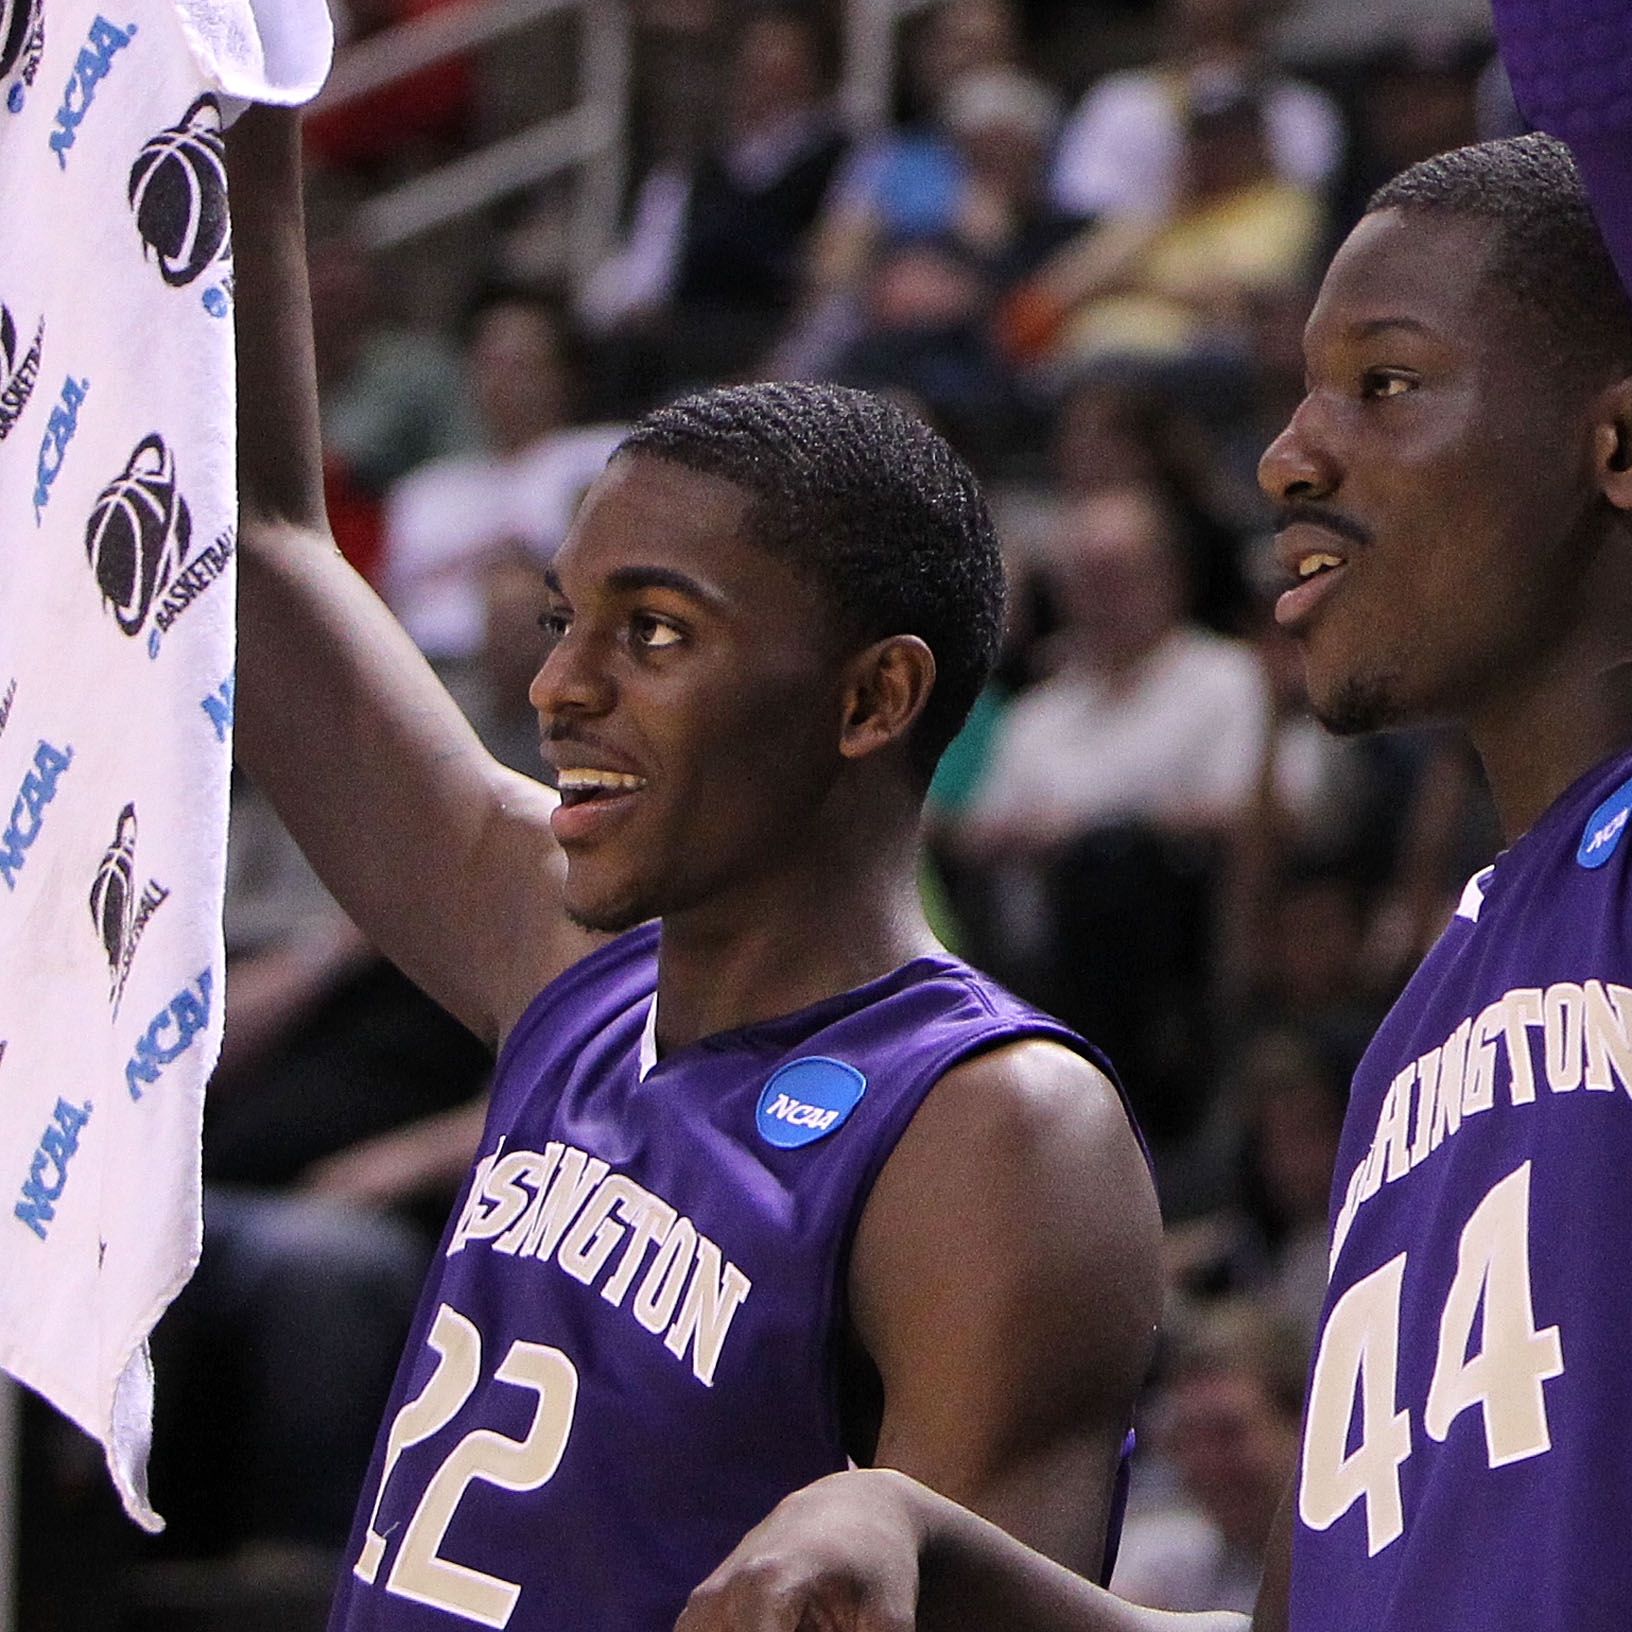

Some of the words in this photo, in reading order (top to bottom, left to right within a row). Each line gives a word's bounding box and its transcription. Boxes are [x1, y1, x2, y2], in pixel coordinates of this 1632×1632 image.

[49, 13, 133, 171] NCAA
[33, 374, 86, 529] NCAA
[14, 1096, 89, 1240] NCAA
[766, 1093, 840, 1130] NCAA
[1299, 1160, 1565, 1557] 44
[353, 1303, 579, 1630] 22
